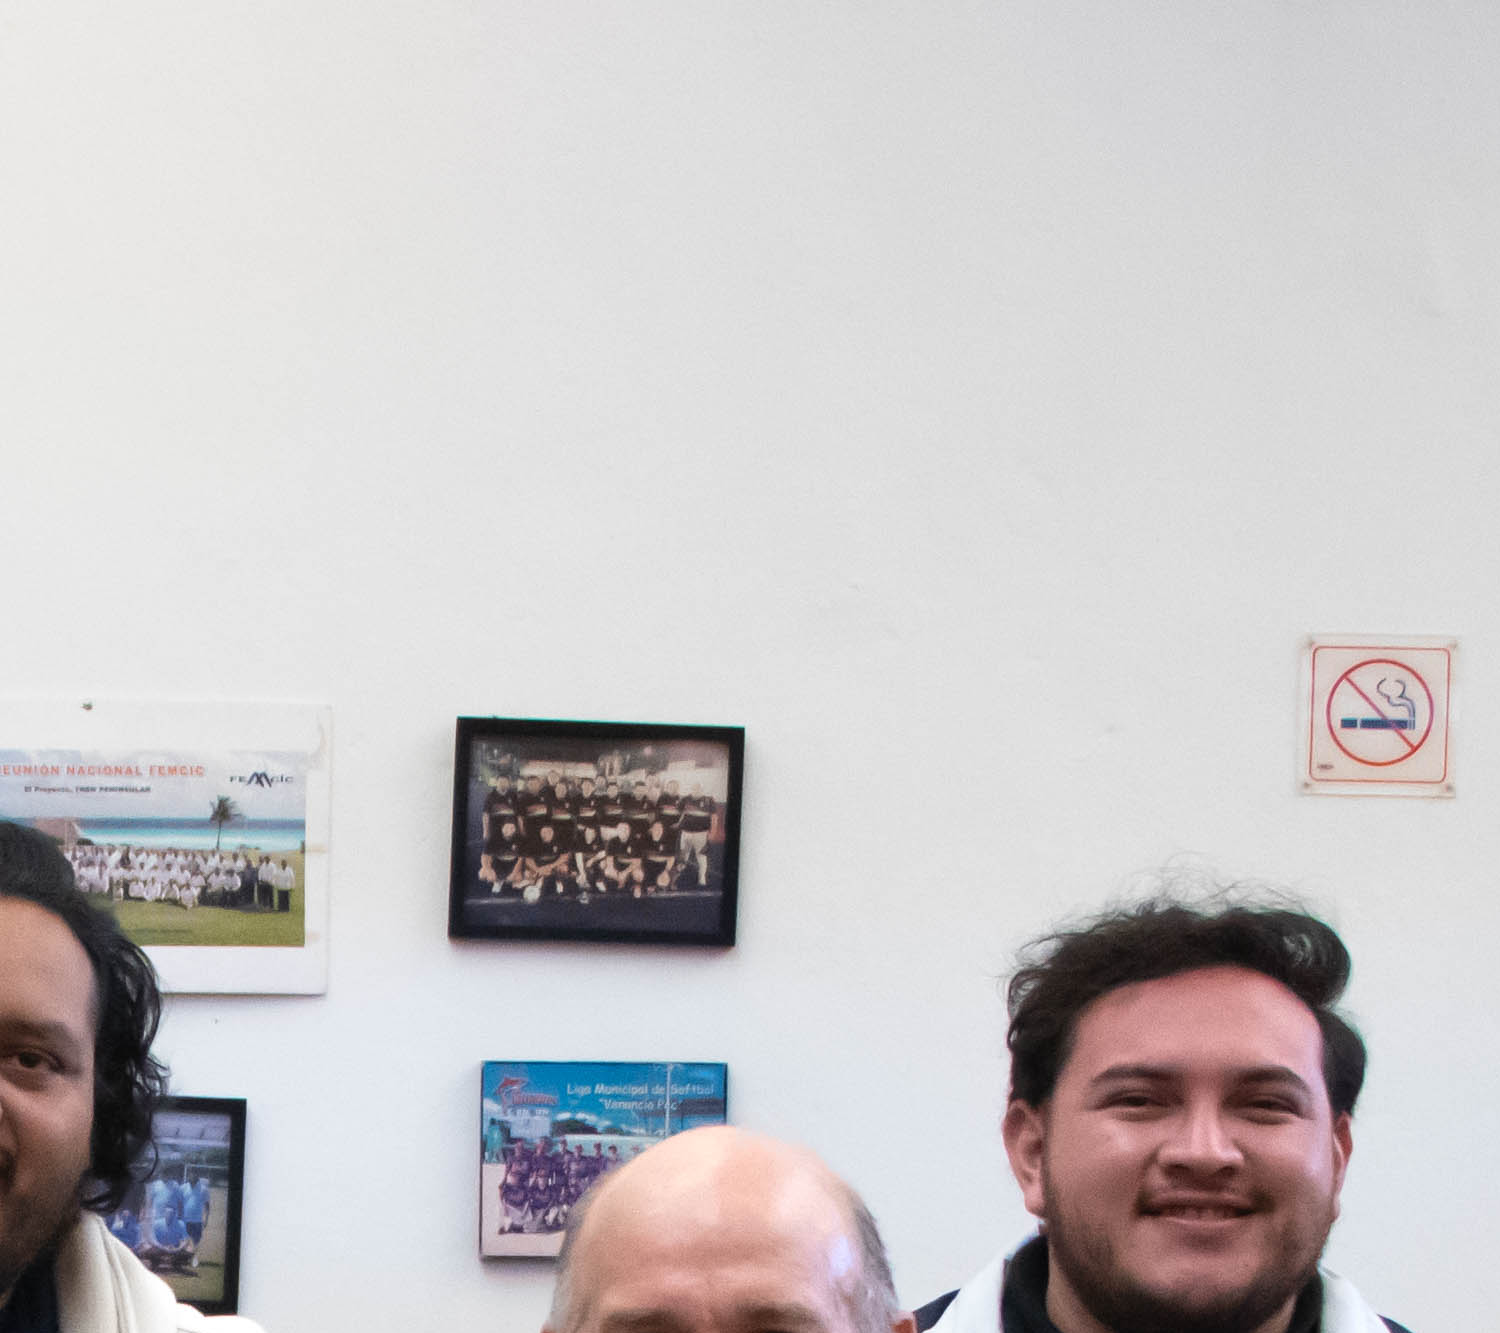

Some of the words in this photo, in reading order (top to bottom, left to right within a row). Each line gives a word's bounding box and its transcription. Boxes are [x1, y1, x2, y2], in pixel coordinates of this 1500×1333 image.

[66, 764, 143, 777] NACIONAL
[567, 1083, 591, 1097] Liga
[594, 1083, 649, 1097] Municipal
